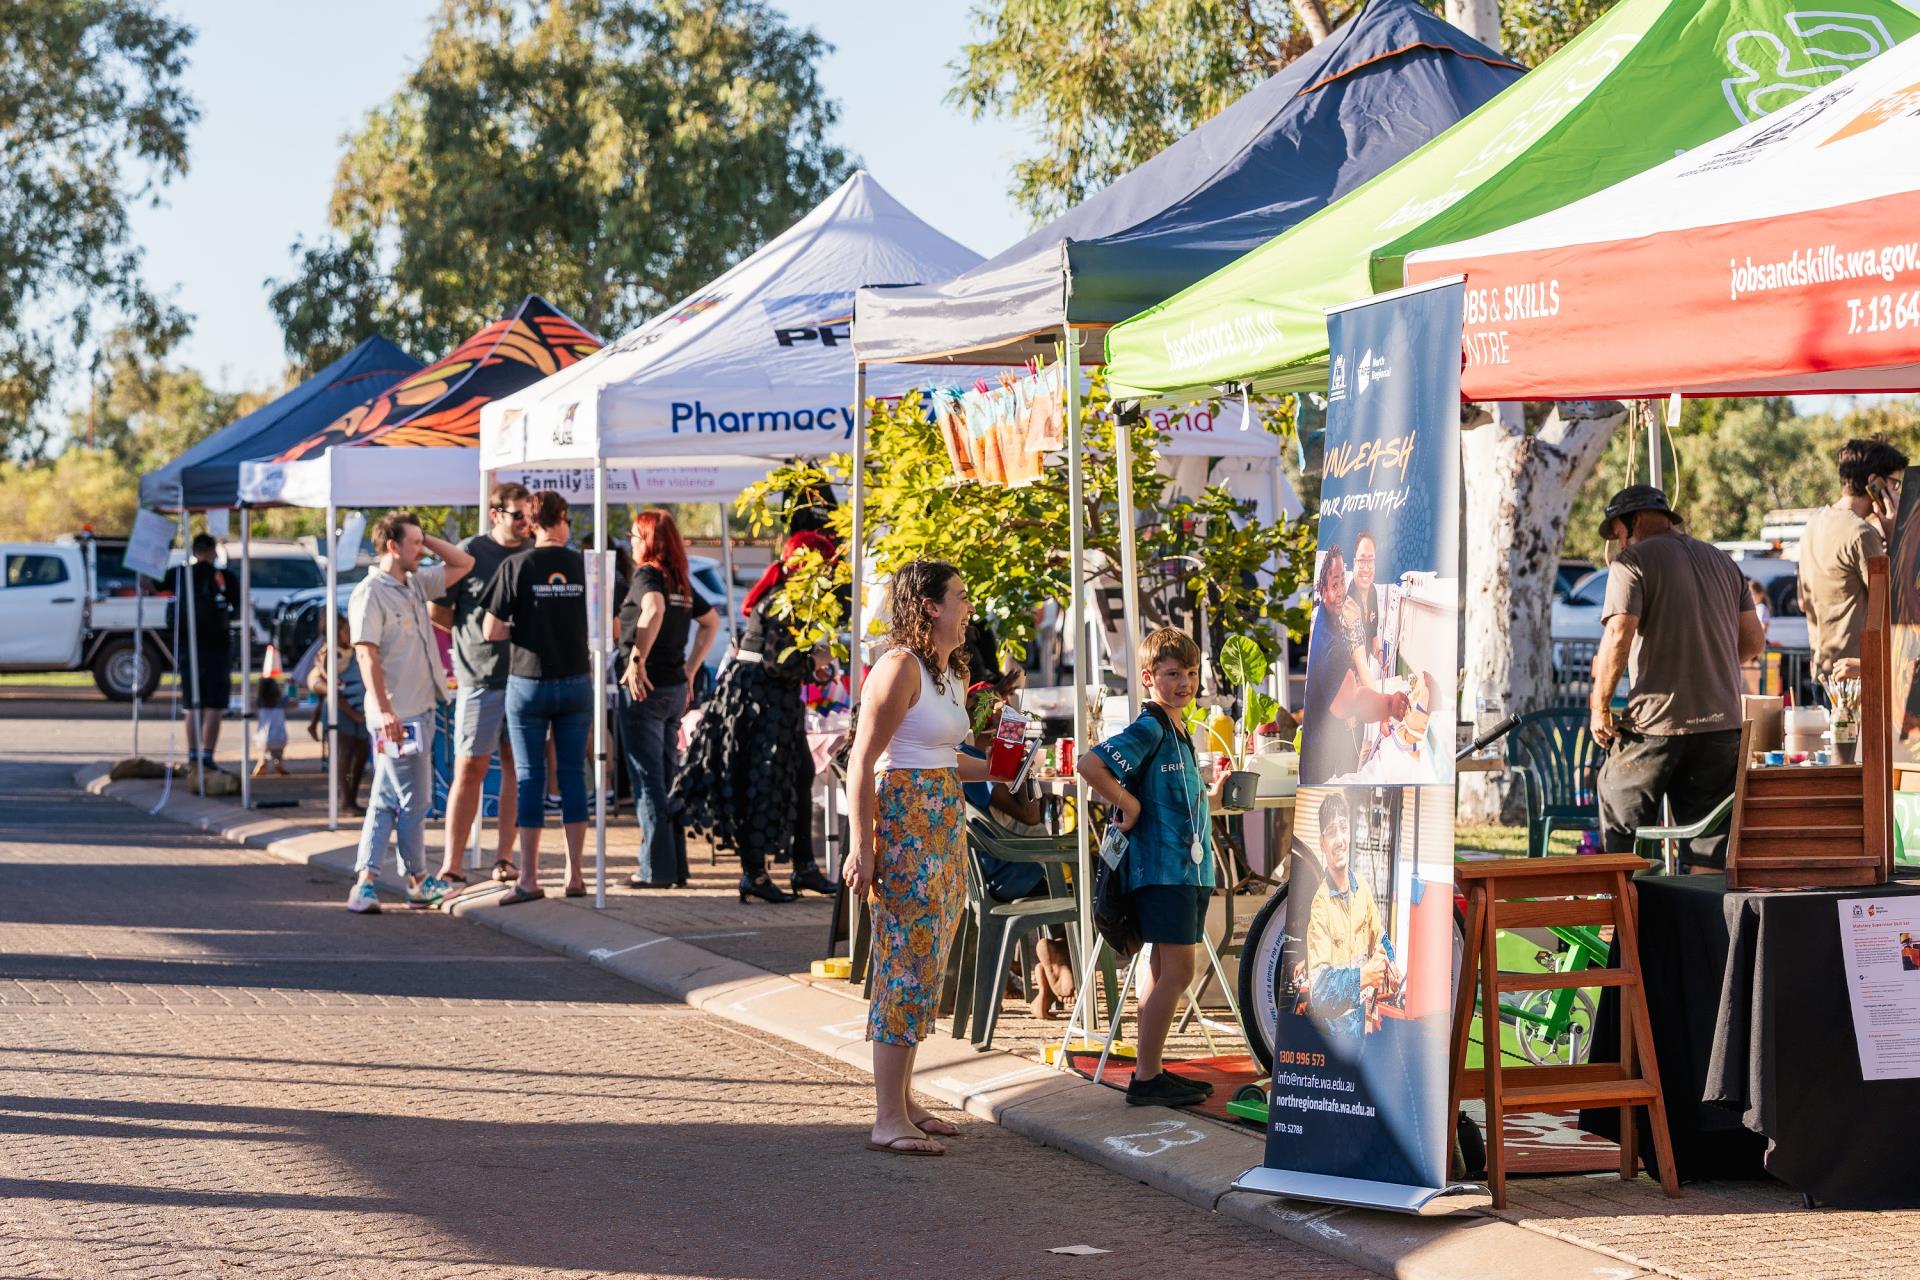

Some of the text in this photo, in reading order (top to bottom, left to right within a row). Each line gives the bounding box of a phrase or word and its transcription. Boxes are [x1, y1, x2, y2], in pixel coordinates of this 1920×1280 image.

[1490, 287, 1501, 323] &
[1504, 279, 1560, 321] SKILLS
[1847, 291, 1920, 334] T: 13 64
[671, 401, 854, 440] Pharmacy
[1322, 429, 1416, 488] UNLEASH
[522, 473, 582, 493] Family
[1319, 485, 1410, 522] YOUR POTENTIAL!
[1111, 751, 1133, 772] BAY
[1279, 1050, 1325, 1067] 1300 996 573
[1277, 1070, 1355, 1093] info@nrtafe.wa.edu.au
[1276, 1094, 1376, 1117] northregionaltafe.wa.edu.au
[1274, 1122, 1303, 1135] RTO: 52788
